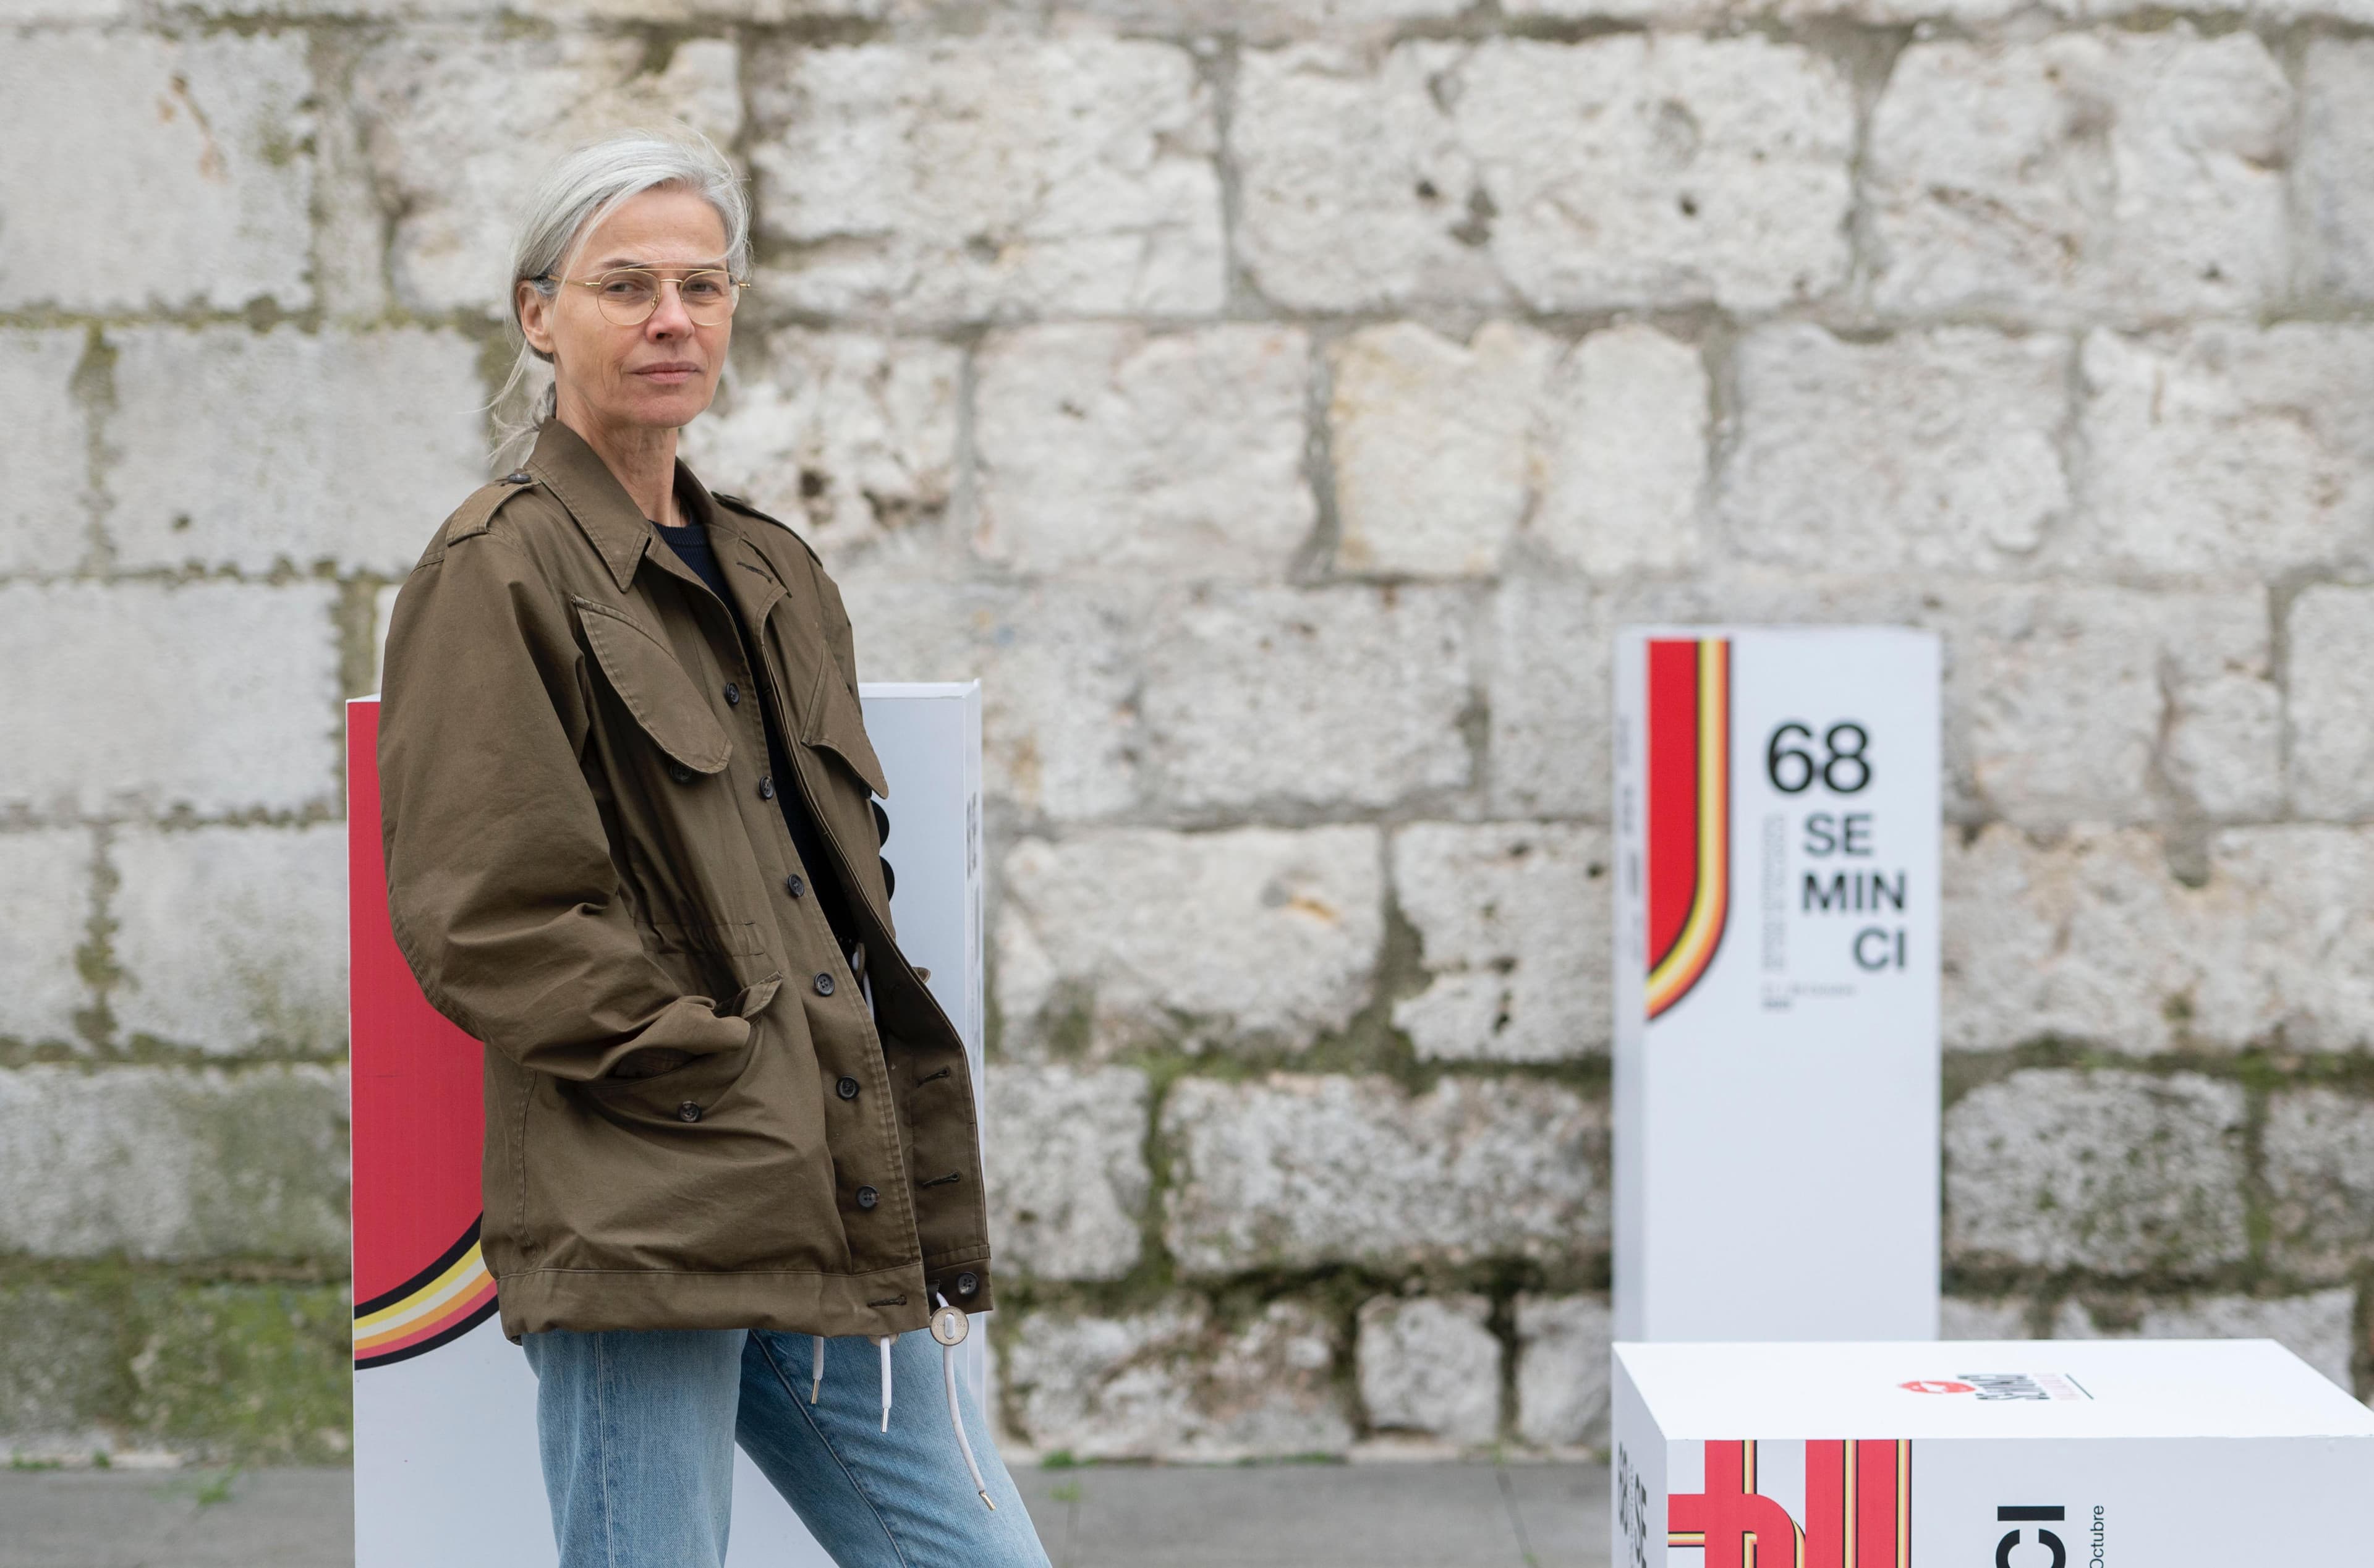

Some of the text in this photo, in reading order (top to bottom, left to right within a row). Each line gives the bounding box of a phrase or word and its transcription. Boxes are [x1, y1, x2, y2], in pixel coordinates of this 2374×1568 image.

[1765, 721, 1873, 795] 68
[1803, 813, 1873, 858] SE
[1802, 870, 1907, 913] MIN
[1852, 926, 1907, 972] CI
[1618, 1442, 1628, 1536] 68
[1996, 1506, 2066, 1568] CI
